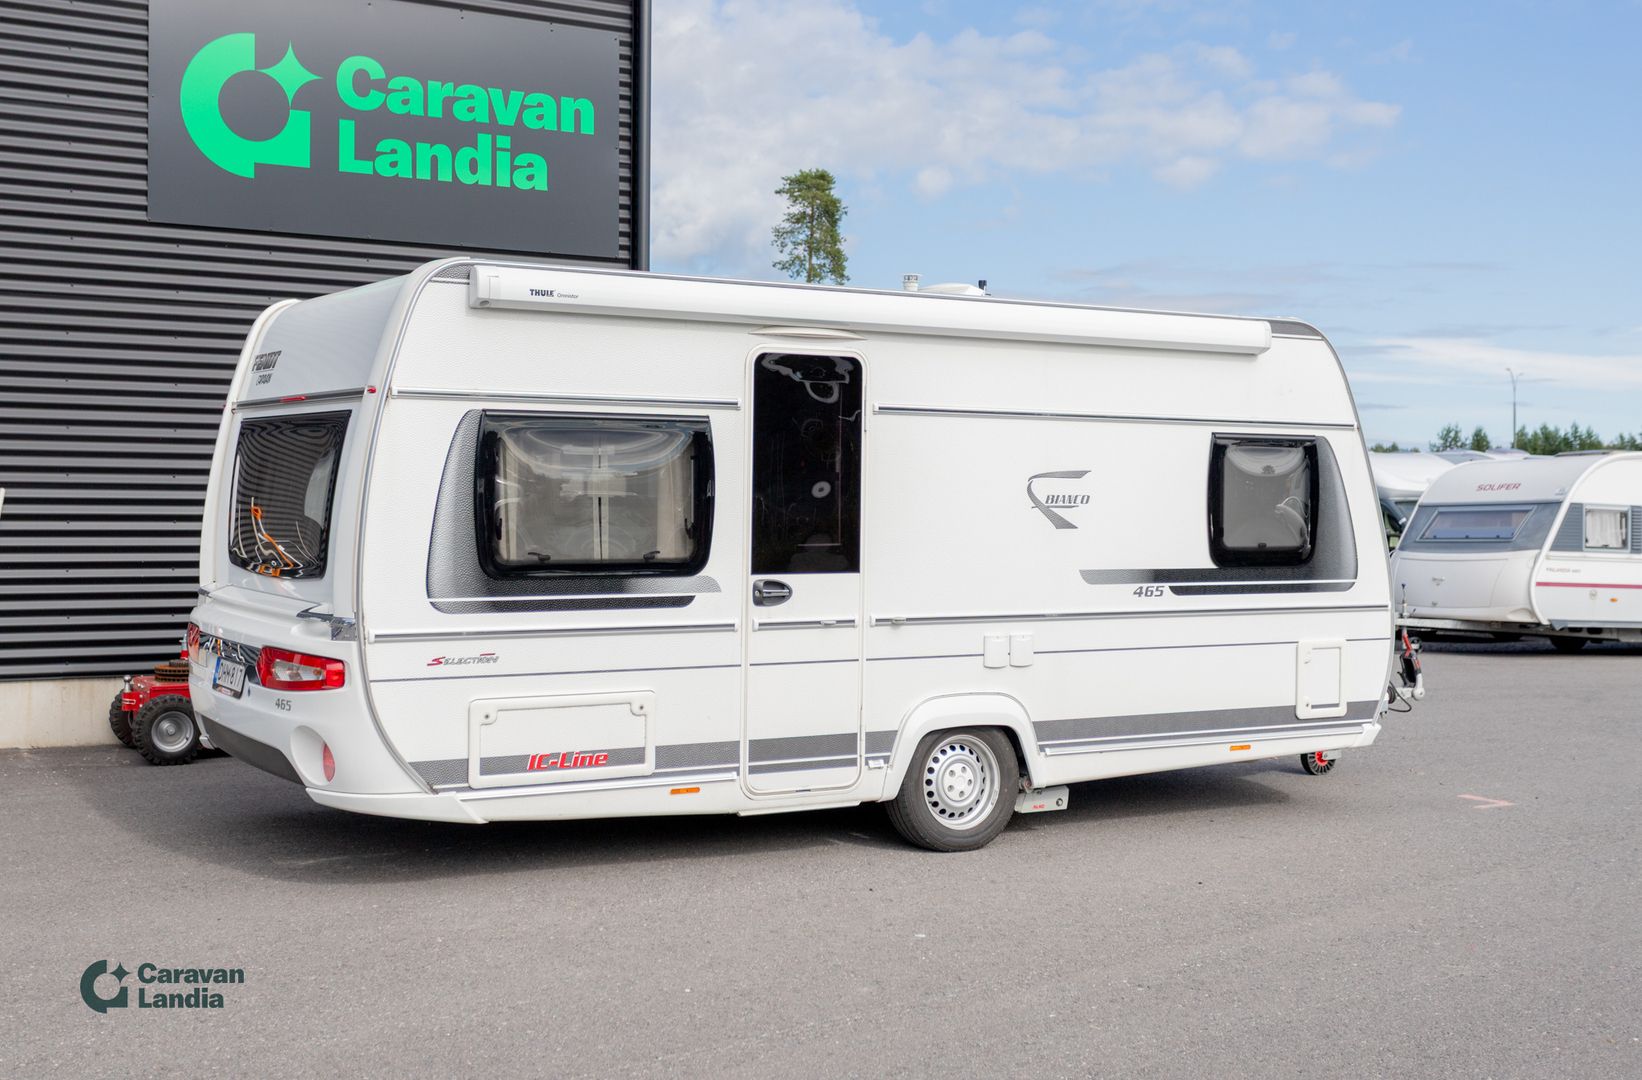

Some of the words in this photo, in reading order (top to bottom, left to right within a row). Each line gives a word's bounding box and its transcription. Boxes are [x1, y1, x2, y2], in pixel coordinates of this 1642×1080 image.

[336, 55, 596, 136] Caravan
[338, 118, 549, 192] Landia
[529, 288, 555, 298] THULE
[1476, 482, 1522, 492] SOLIFER
[1044, 494, 1091, 505] BIANCO
[1132, 585, 1165, 598] 465
[275, 698, 292, 712] 465
[527, 751, 609, 771] IC-Line
